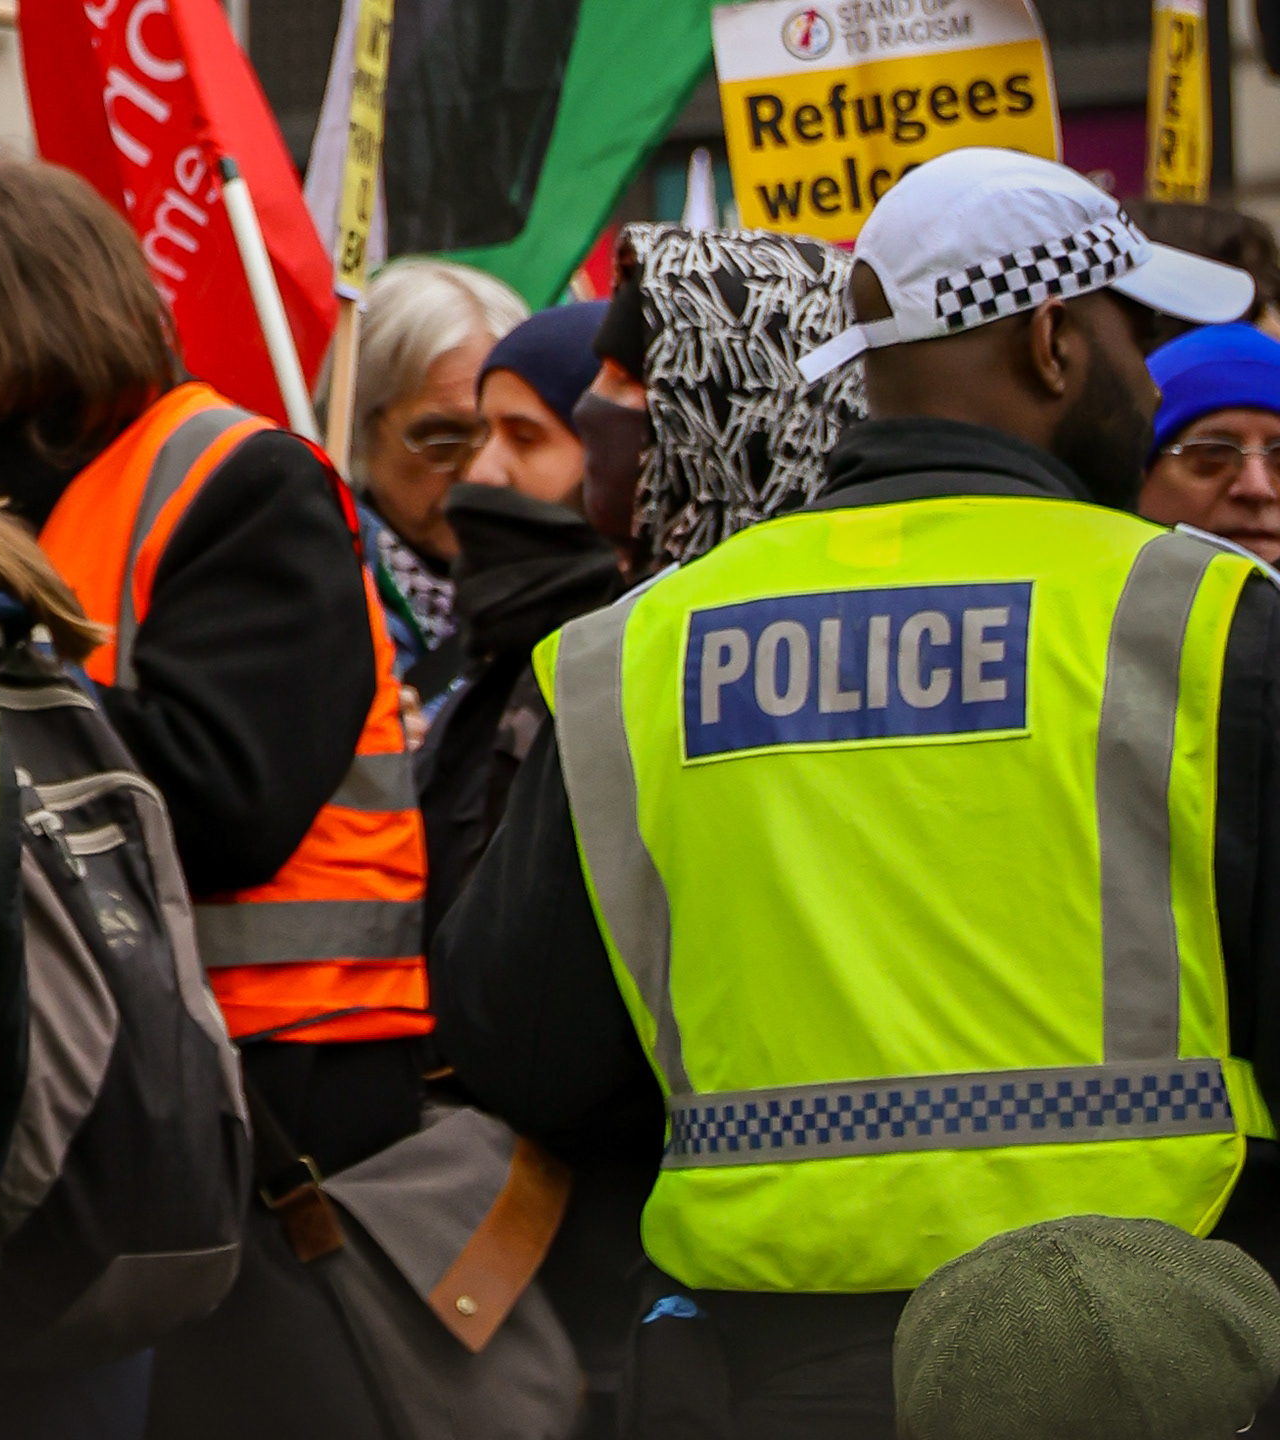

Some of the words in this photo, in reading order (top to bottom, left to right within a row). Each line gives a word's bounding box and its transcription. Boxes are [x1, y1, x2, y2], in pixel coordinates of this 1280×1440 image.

[842, 31, 871, 56] TO
[878, 13, 973, 49] RACISM
[744, 72, 1036, 151] Refugees
[699, 605, 1011, 726] POLICE
